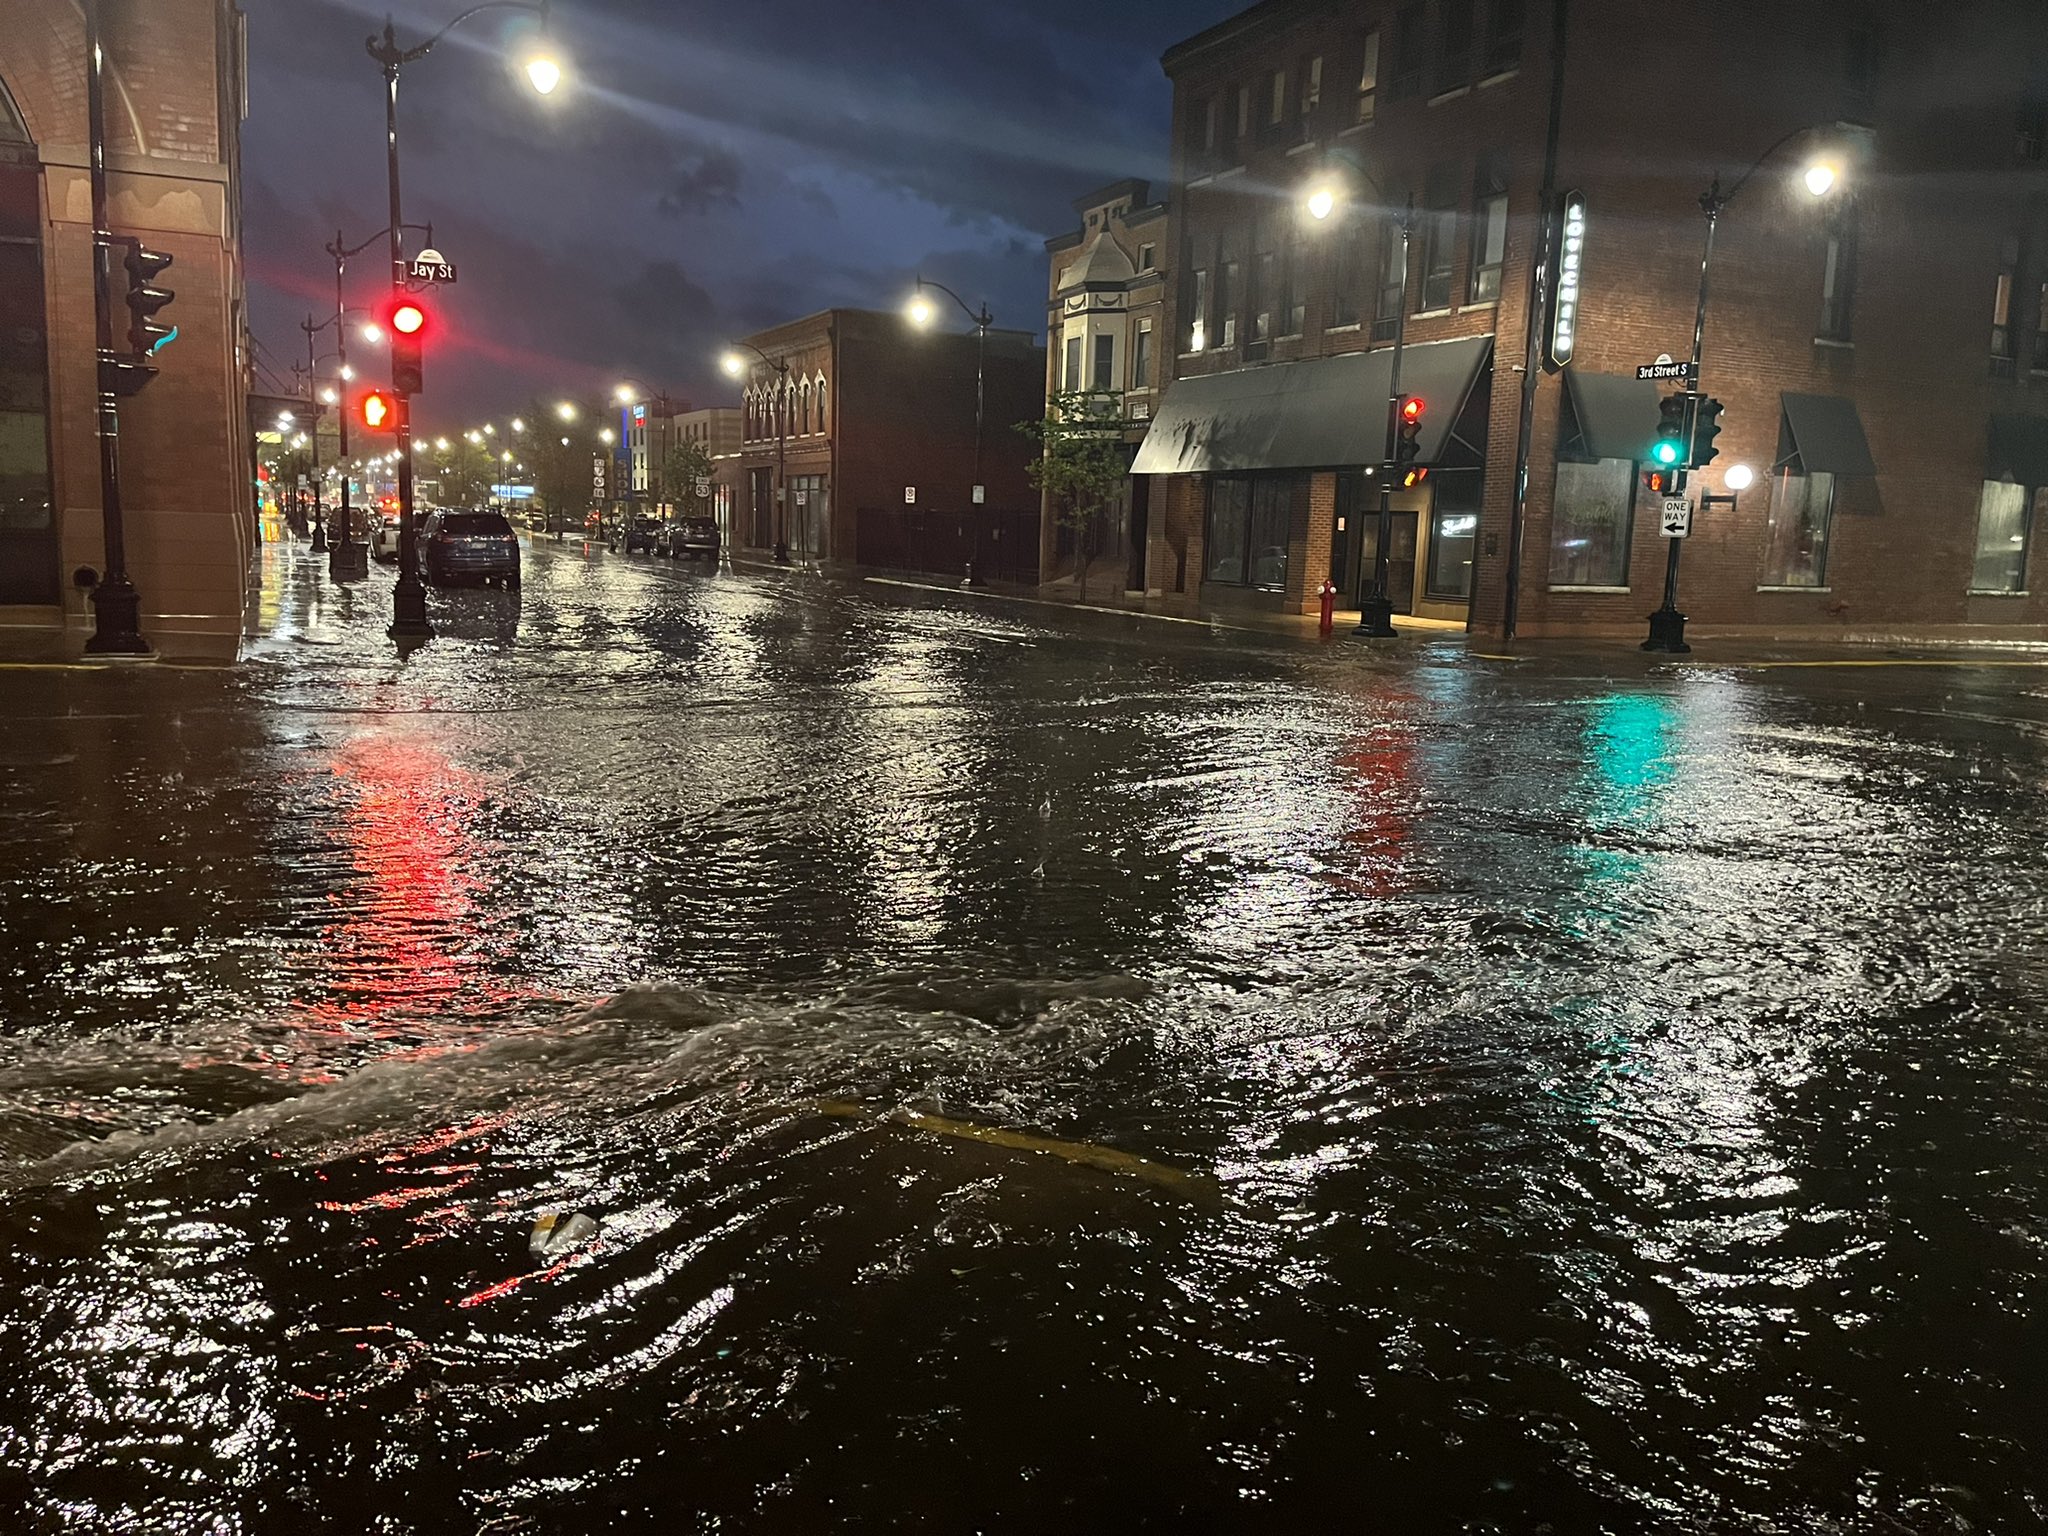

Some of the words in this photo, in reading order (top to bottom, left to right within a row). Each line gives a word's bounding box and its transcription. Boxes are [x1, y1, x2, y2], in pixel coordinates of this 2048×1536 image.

[410, 261, 435, 281] Jay
[439, 264, 453, 278] St
[1639, 366, 1654, 379] 3rd
[1654, 364, 1679, 377] Street
[1680, 363, 1687, 375] S
[697, 485, 708, 496] 53
[1666, 502, 1687, 511] ONE
[1664, 512, 1686, 521] WAY
